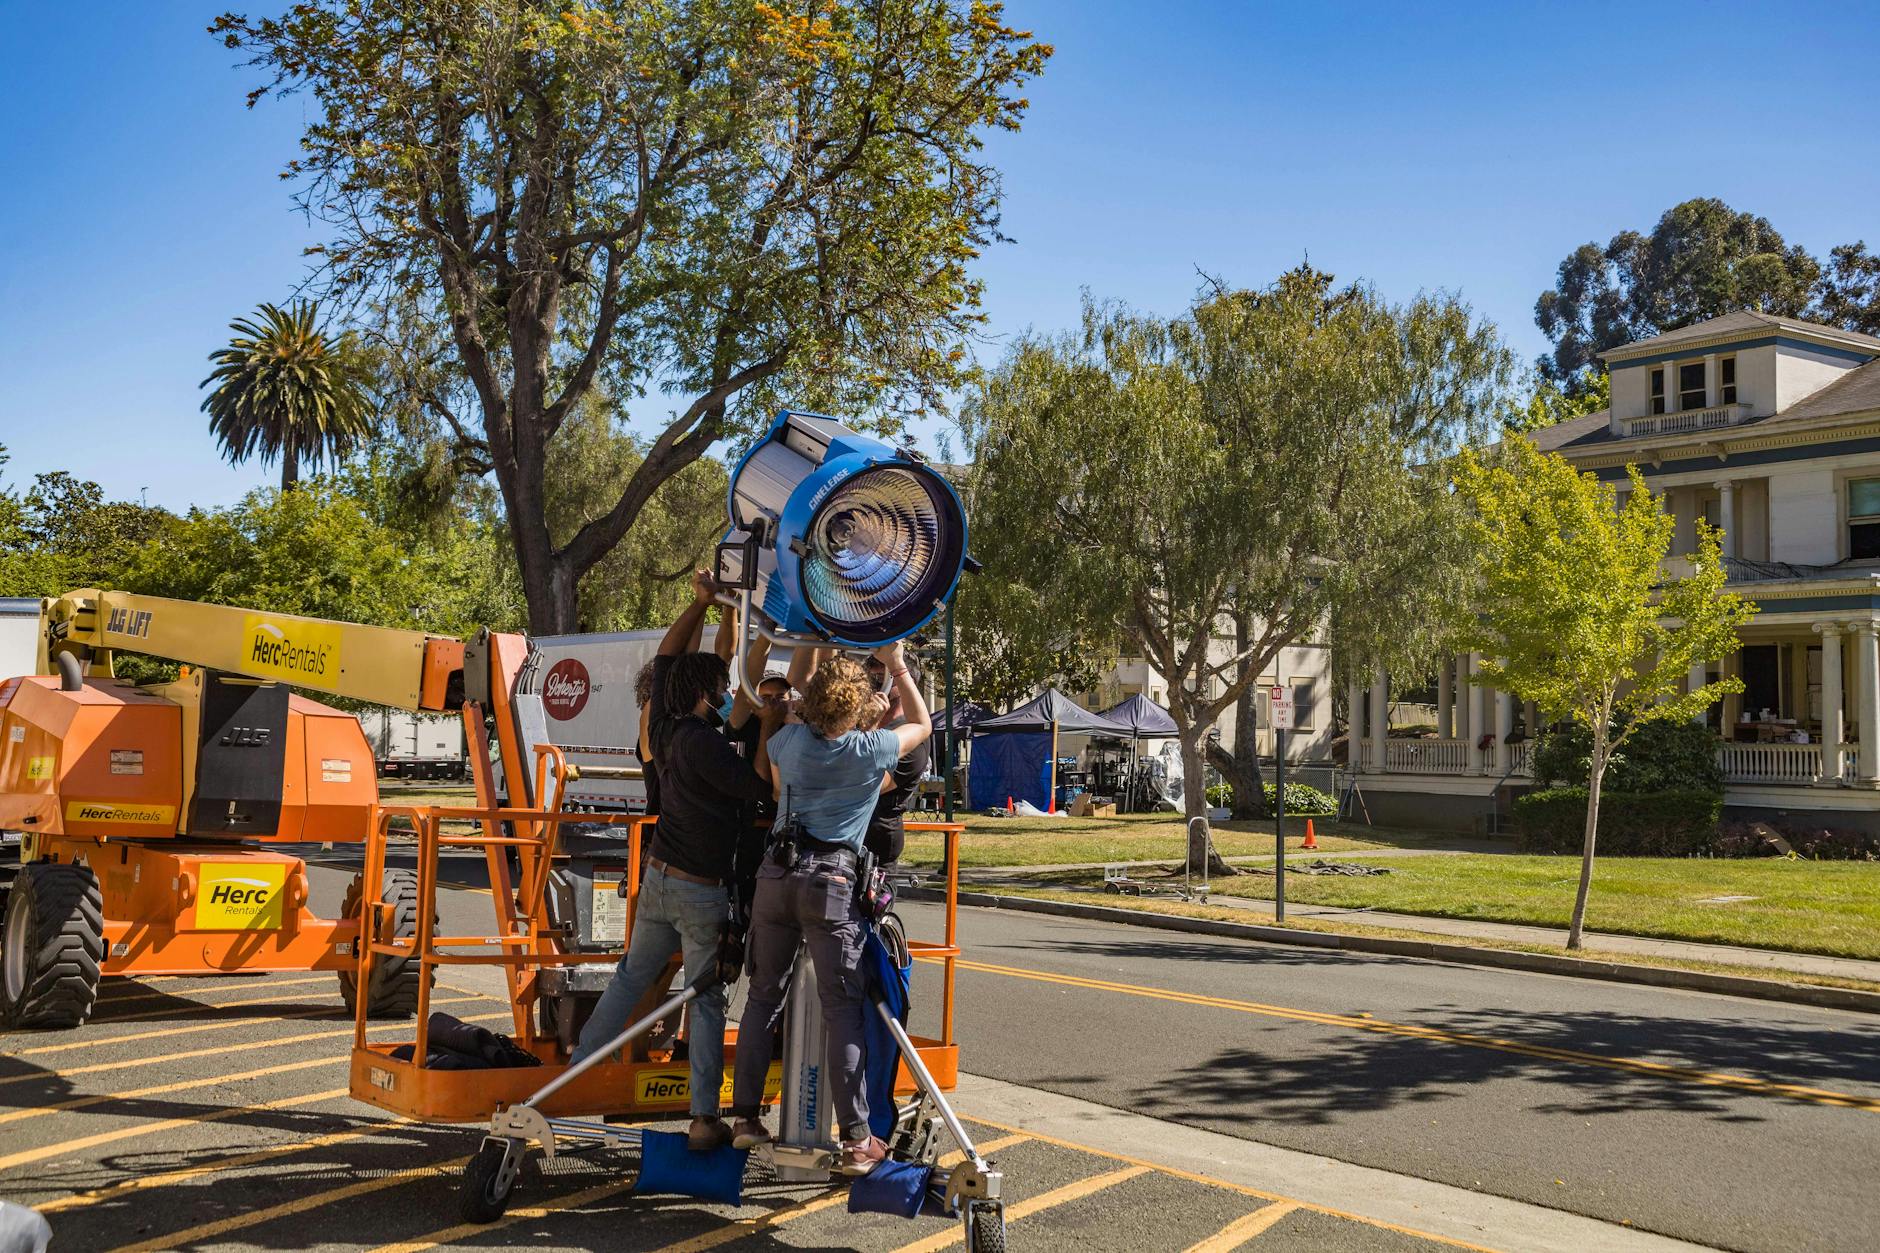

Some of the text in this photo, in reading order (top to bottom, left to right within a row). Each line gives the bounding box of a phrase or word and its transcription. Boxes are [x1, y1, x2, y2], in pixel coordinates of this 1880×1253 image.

[808, 467, 850, 511] CINELEASE
[106, 607, 153, 639] JLG LIFT
[1272, 688, 1281, 699] NO
[1272, 701, 1292, 709] PARKING
[1277, 716, 1287, 724] TIME
[219, 727, 271, 747] JLG
[210, 885, 269, 904] Herc
[224, 905, 264, 916] Rentals
[805, 1065, 818, 1130] CINELEASE
